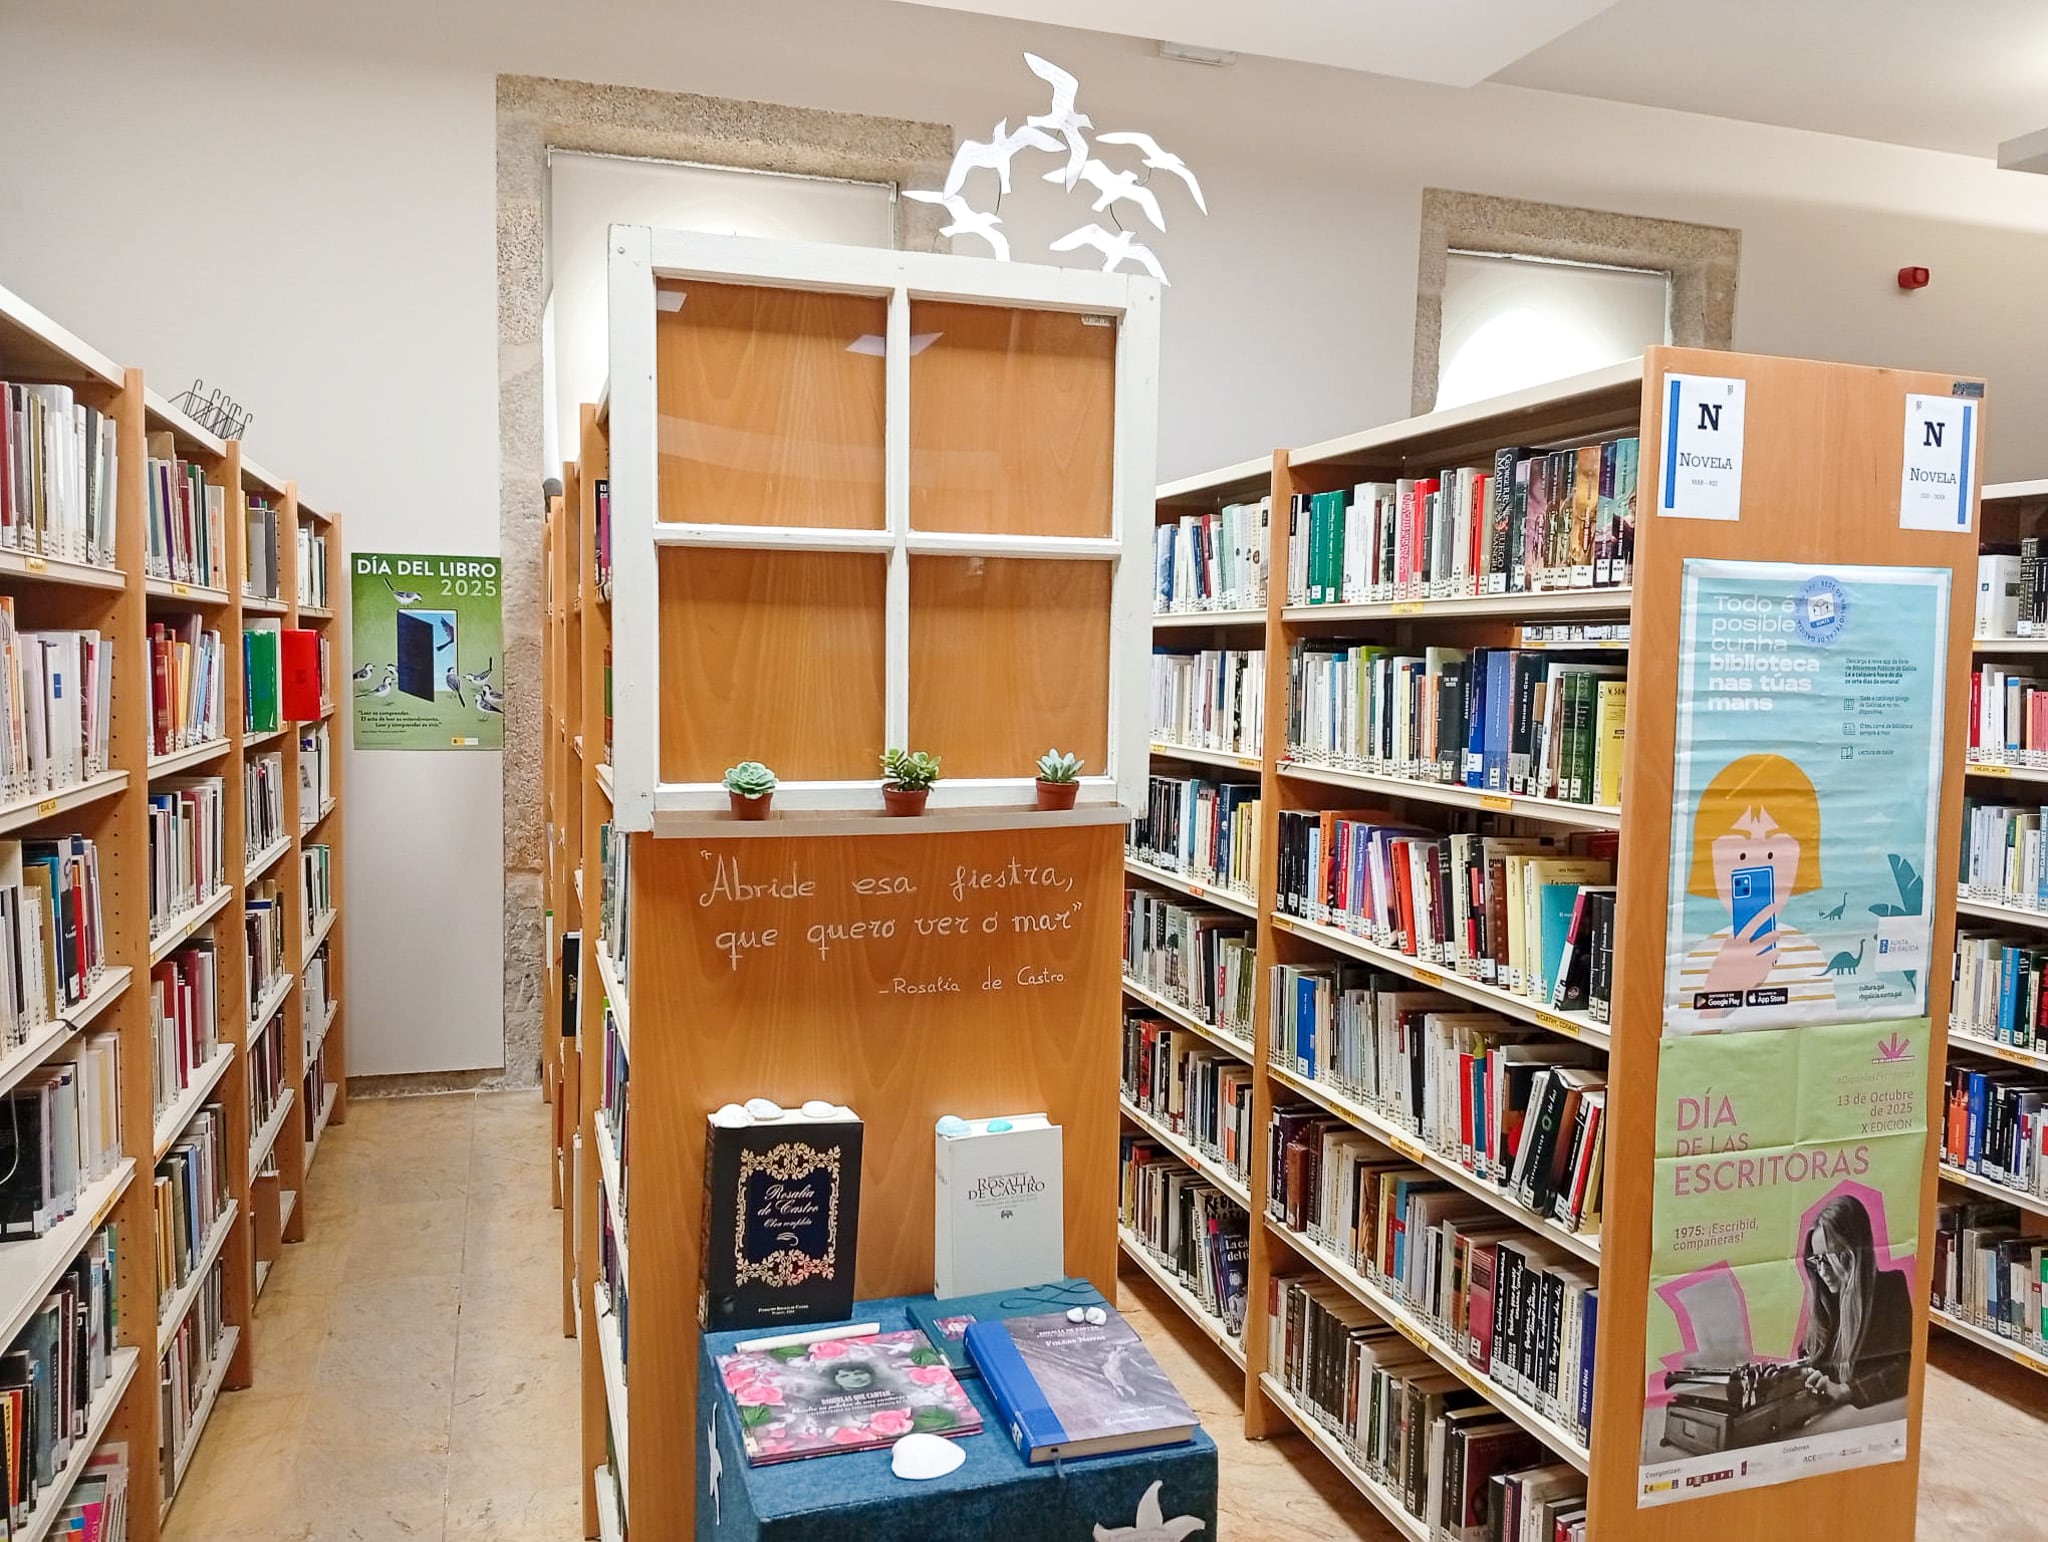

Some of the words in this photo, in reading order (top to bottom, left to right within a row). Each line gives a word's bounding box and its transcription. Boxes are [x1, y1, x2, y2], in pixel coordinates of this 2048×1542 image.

[1697, 403, 1722, 432] N
[1922, 421, 1945, 448] N
[1679, 452, 1733, 470] NOVELA
[1910, 467, 1957, 485] NOVELA
[357, 556, 392, 575] DÍA
[397, 561, 435, 576] DEL
[439, 562, 497, 578] LIBRO
[441, 579, 497, 597] 2025
[1713, 594, 1773, 612] Todo
[1711, 616, 1796, 636] posible
[1711, 635, 1788, 652] cunha
[1709, 654, 1820, 672] biblioteca
[1708, 675, 1752, 692] nas
[1760, 673, 1812, 692] túas
[1707, 696, 1773, 712] mans
[852, 875, 917, 895] esa
[715, 926, 778, 971] que
[807, 918, 895, 961] quero
[914, 915, 969, 938] ver
[981, 965, 1002, 992] de
[1017, 964, 1064, 987] Castro
[1708, 998, 1728, 1006] Google
[1728, 998, 1740, 1006] Play
[1758, 996, 1770, 1004] App
[1837, 1095, 1850, 1106] 13
[1853, 1092, 1866, 1105] de
[1870, 1088, 1914, 1103] Octubre
[1676, 1087, 1738, 1132] DÍA
[1870, 1105, 1884, 1116] de
[1887, 1102, 1913, 1115] 2025
[1861, 1123, 1868, 1134] X
[1676, 1138, 1703, 1157] DE
[1674, 1145, 1870, 1196] ESCRITORAS
[764, 1183, 816, 1201] Rosalía
[968, 1190, 986, 1200] DE
[990, 1181, 1046, 1198] CASTRO
[757, 1202, 772, 1217] de
[775, 1199, 819, 1215] Castro
[1674, 1225, 1705, 1240] 1975:
[1225, 1239, 1237, 1250] La
